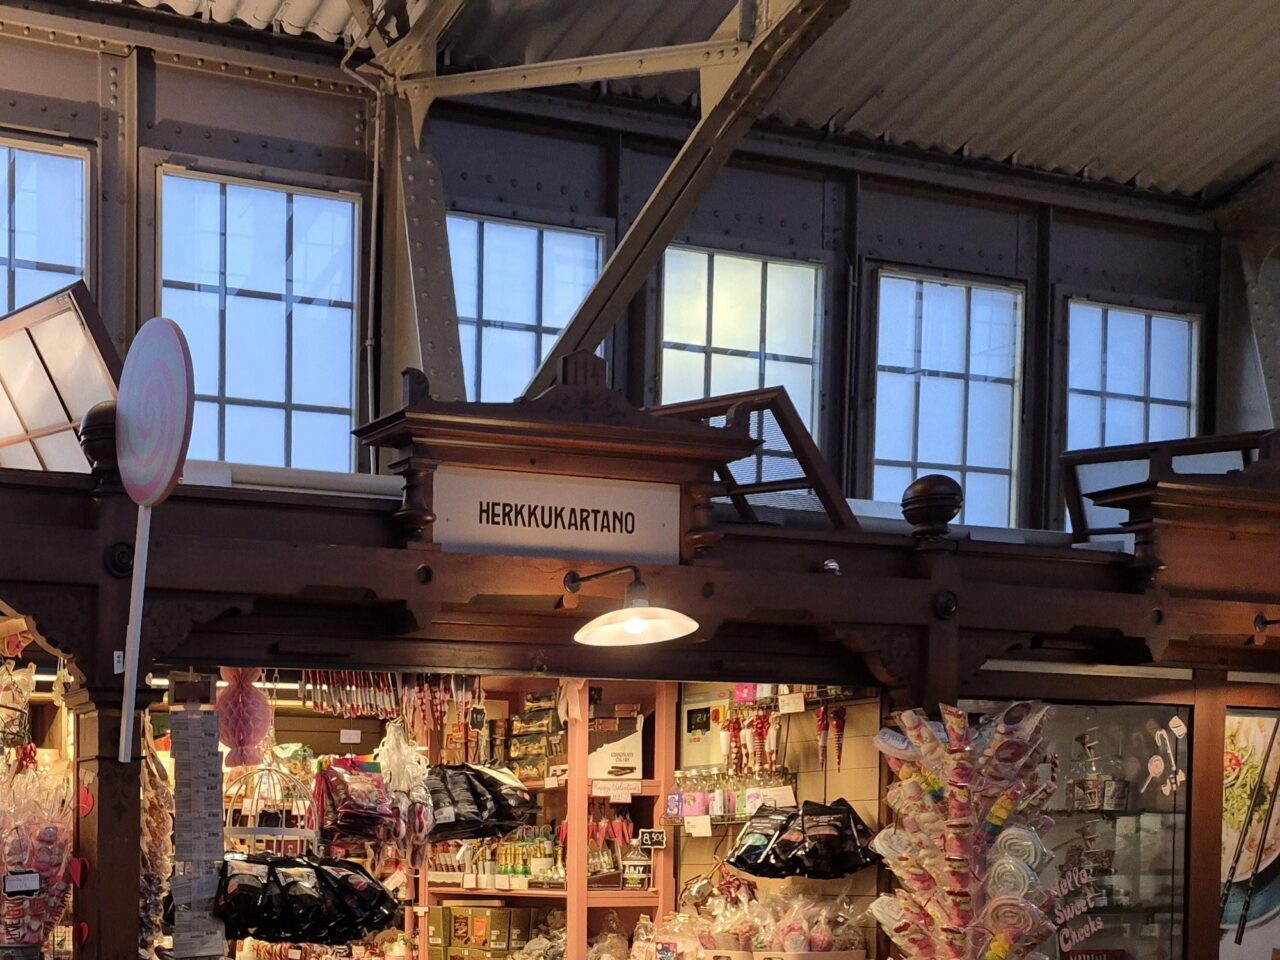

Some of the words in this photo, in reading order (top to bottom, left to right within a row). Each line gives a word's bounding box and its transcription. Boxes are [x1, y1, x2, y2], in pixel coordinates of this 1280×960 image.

[478, 500, 636, 534] HERKKUKARTANO
[643, 832, 664, 845] 8,50€
[1060, 914, 1105, 952] Cheeks
